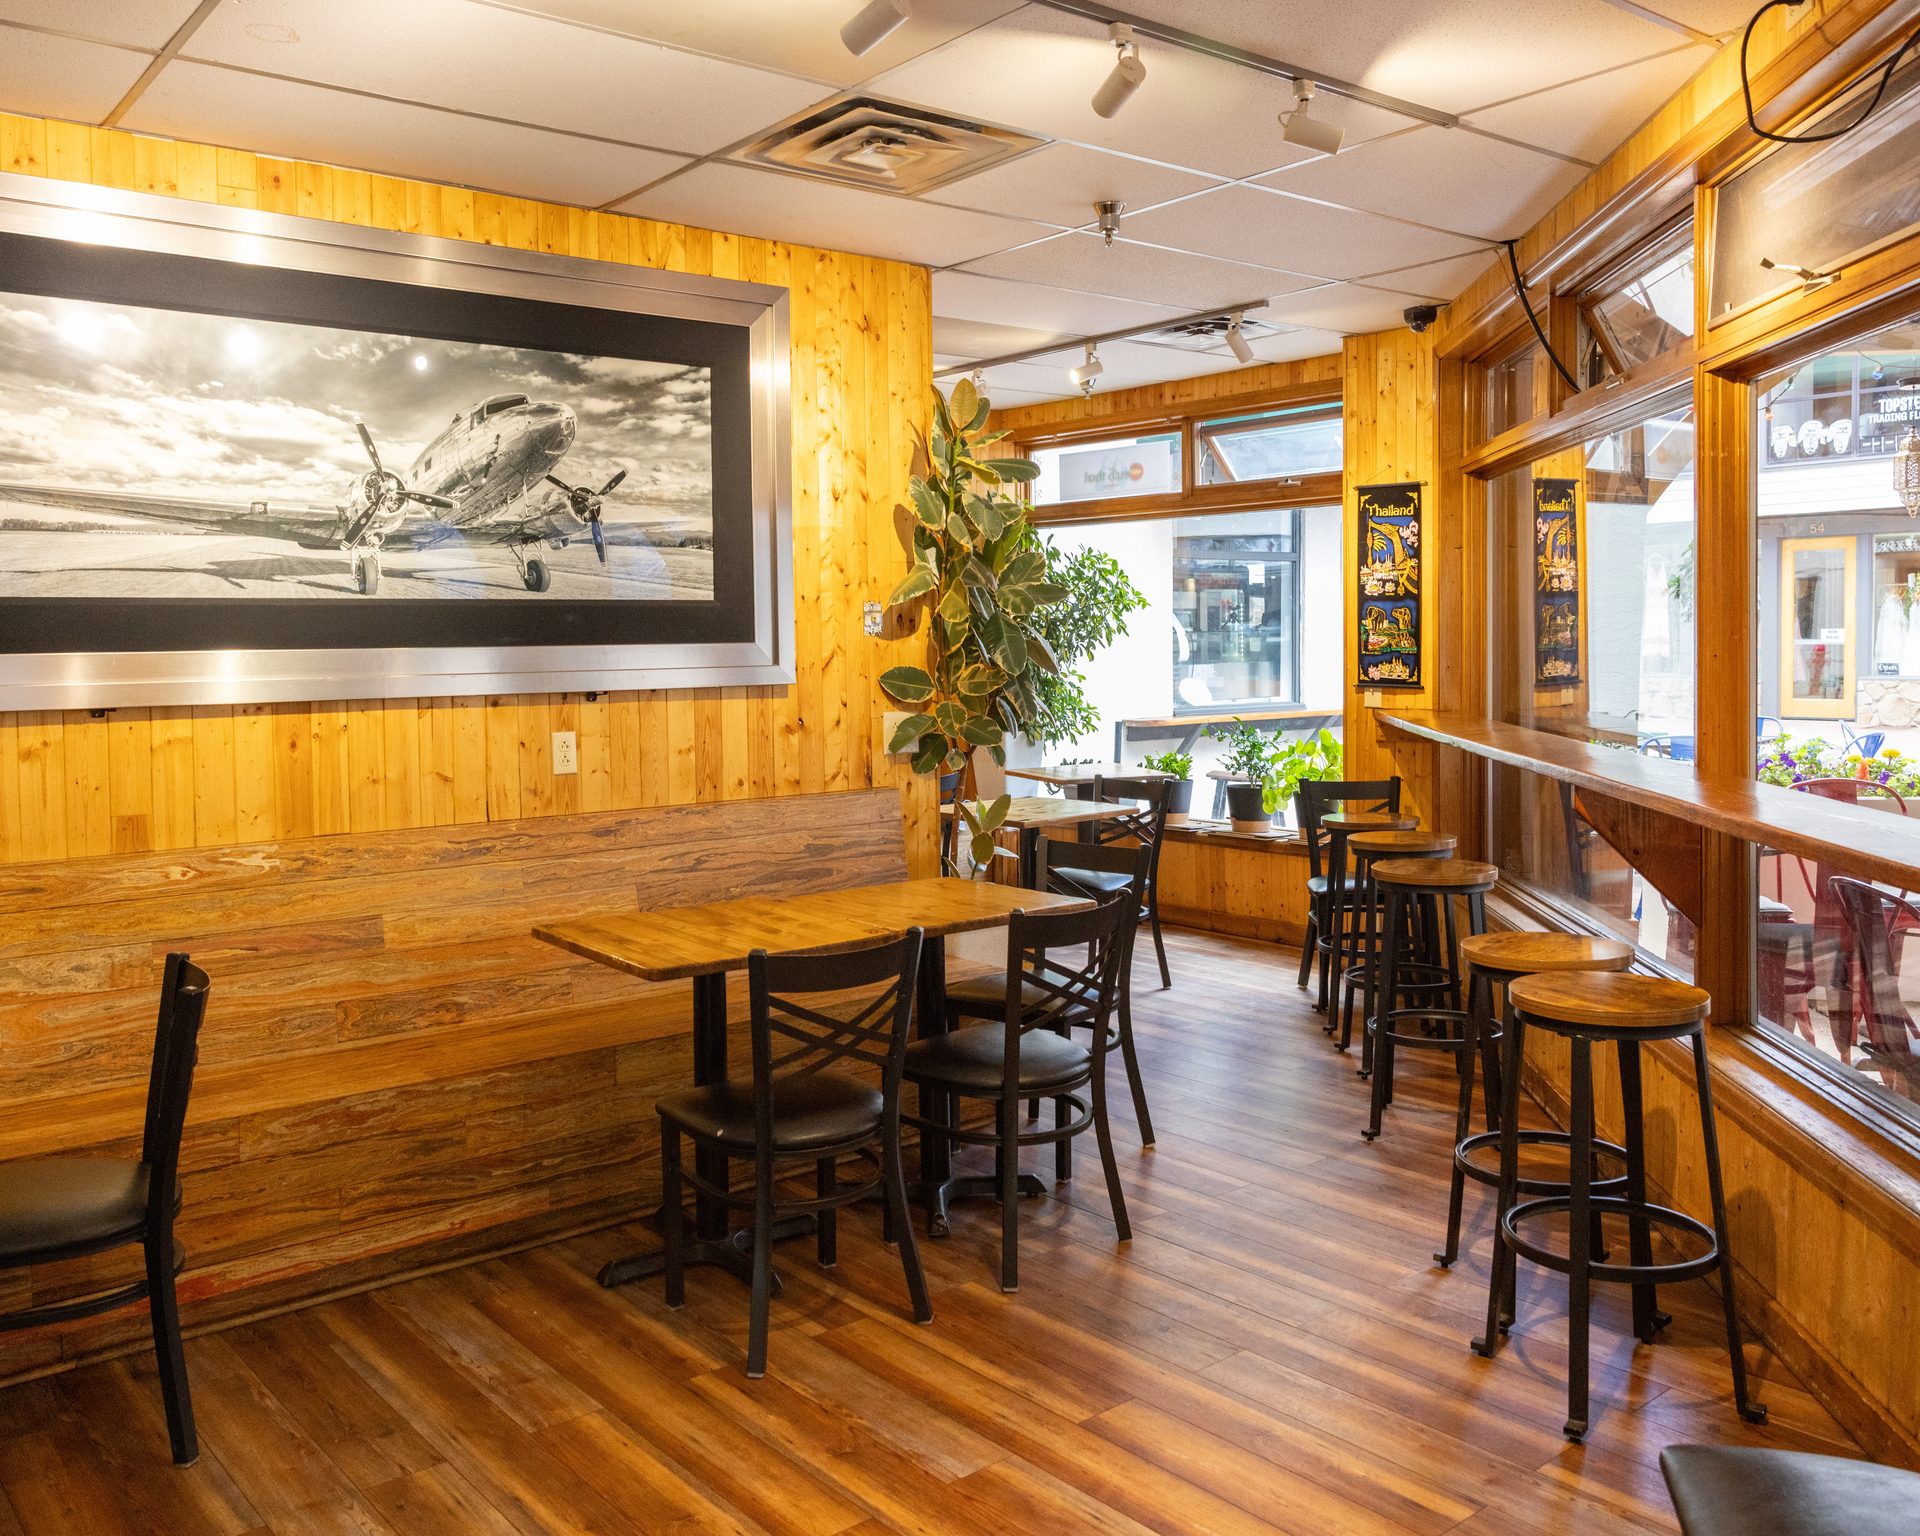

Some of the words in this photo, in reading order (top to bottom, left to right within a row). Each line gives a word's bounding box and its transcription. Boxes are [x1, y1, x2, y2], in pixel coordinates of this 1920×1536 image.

[1868, 411, 1907, 424] TRADING
[1366, 503, 1414, 517] Thailand
[1809, 523, 1825, 533] 54
[1878, 664, 1898, 672] Open
